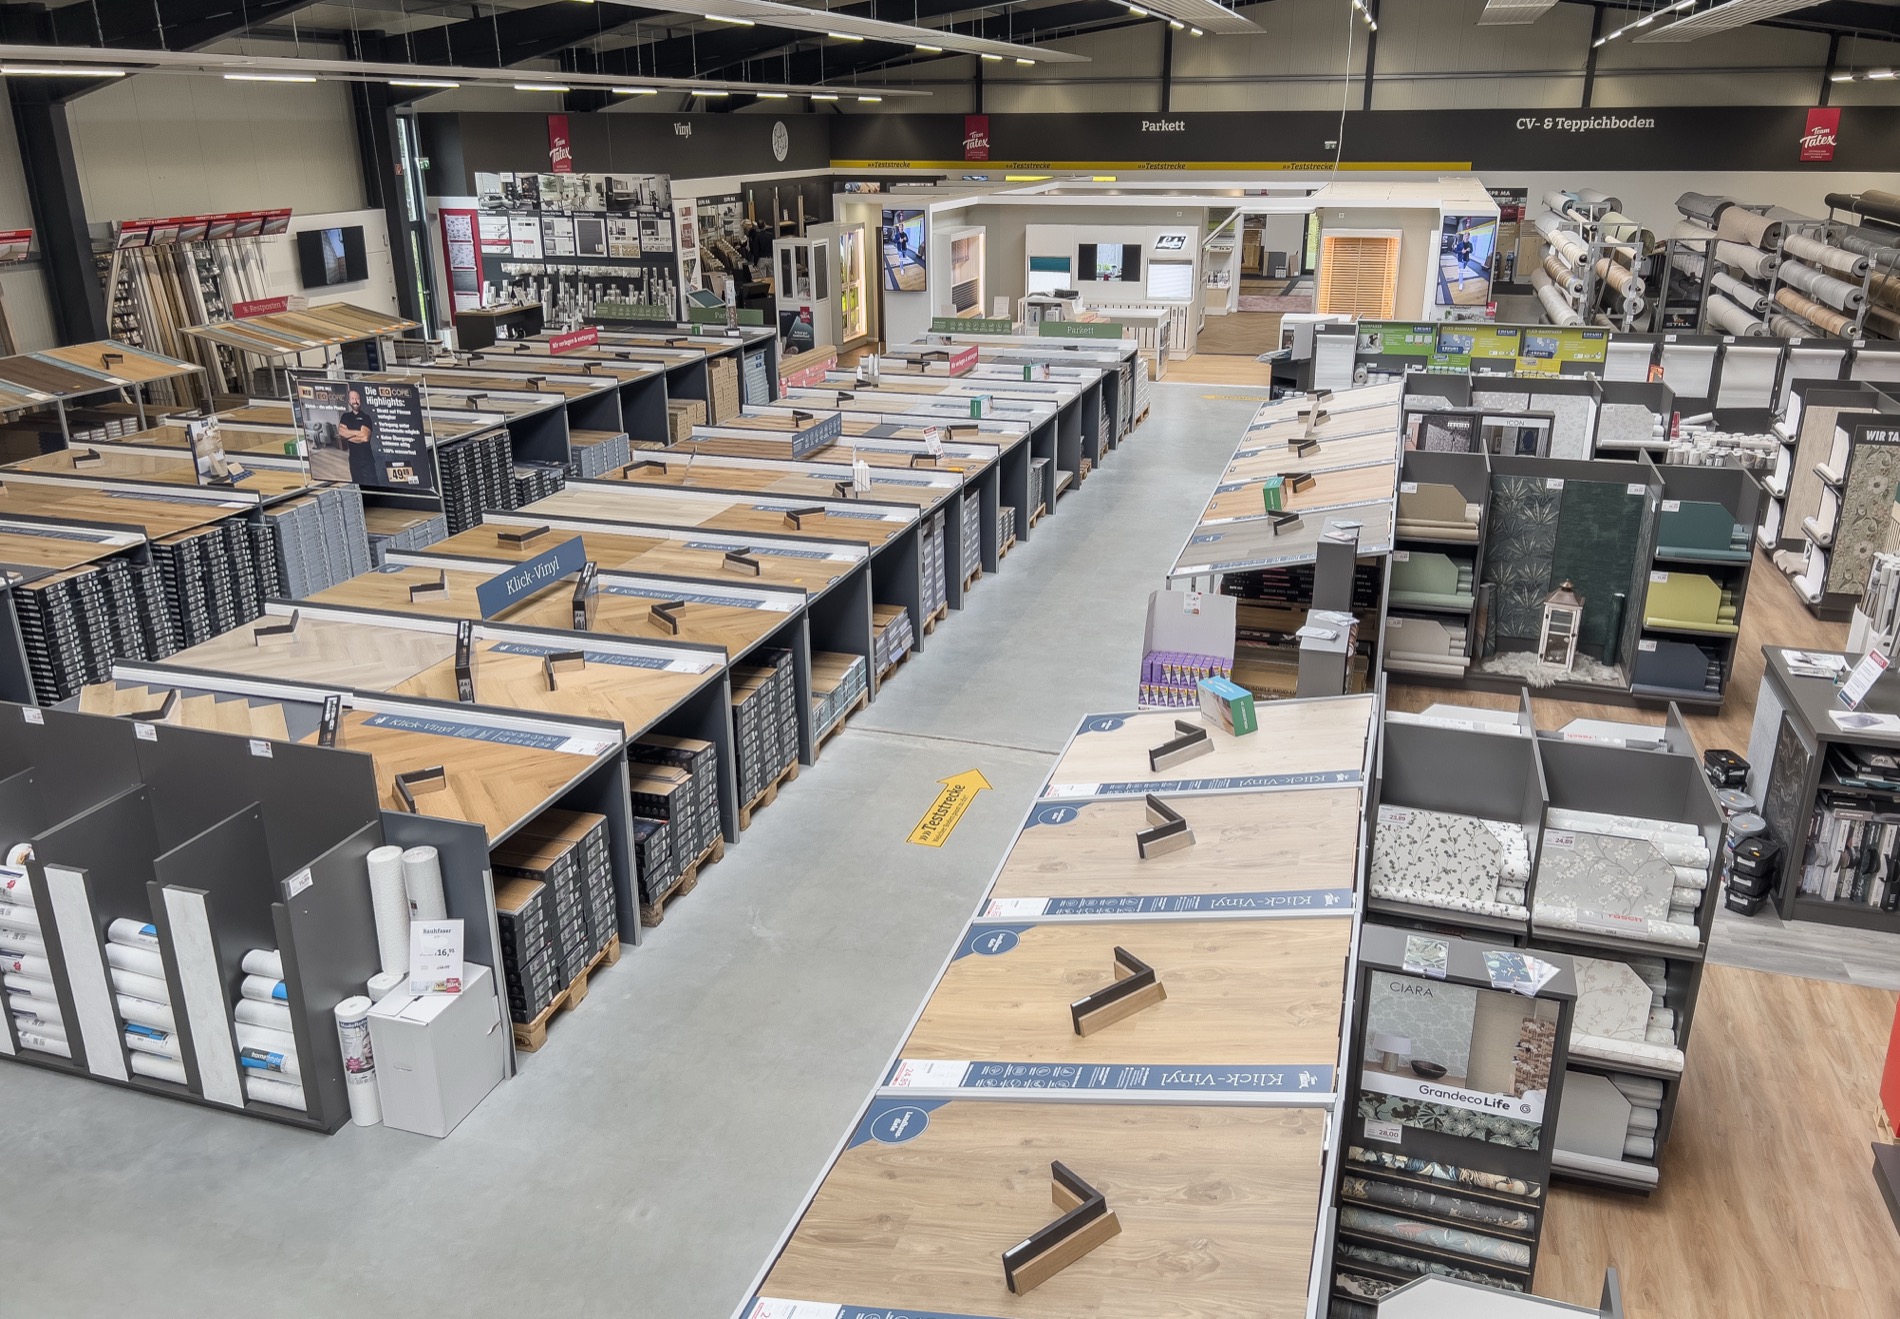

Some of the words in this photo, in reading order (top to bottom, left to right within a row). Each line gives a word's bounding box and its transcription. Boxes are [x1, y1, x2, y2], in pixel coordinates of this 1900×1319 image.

[674, 122, 692, 138] Vinyl
[1141, 120, 1185, 132] Parkett
[1516, 118, 1540, 130] CV-
[1544, 118, 1554, 130] &
[1556, 116, 1654, 132] Teppichboden
[1811, 126, 1830, 135] Team
[963, 138, 990, 150] Tatex
[1800, 134, 1837, 148] Tatex
[550, 146, 572, 164] Tatex
[250, 302, 282, 313] Restposten
[1067, 326, 1094, 335] Parkett
[364, 386, 377, 396] Die
[366, 396, 406, 408] Highlights:
[1866, 430, 1886, 442] WIR
[1888, 431, 1900, 442] TA
[506, 556, 560, 596] Klick-Vinyl
[389, 718, 456, 734] Klick-Vinyl
[1239, 774, 1326, 788] Klick-Vinyl
[1211, 894, 1312, 910] Klick-Vinyl
[1389, 981, 1434, 998] CIARA
[1160, 1069, 1285, 1086] Klick-Vinyl
[1378, 1129, 1399, 1138] 28,00
